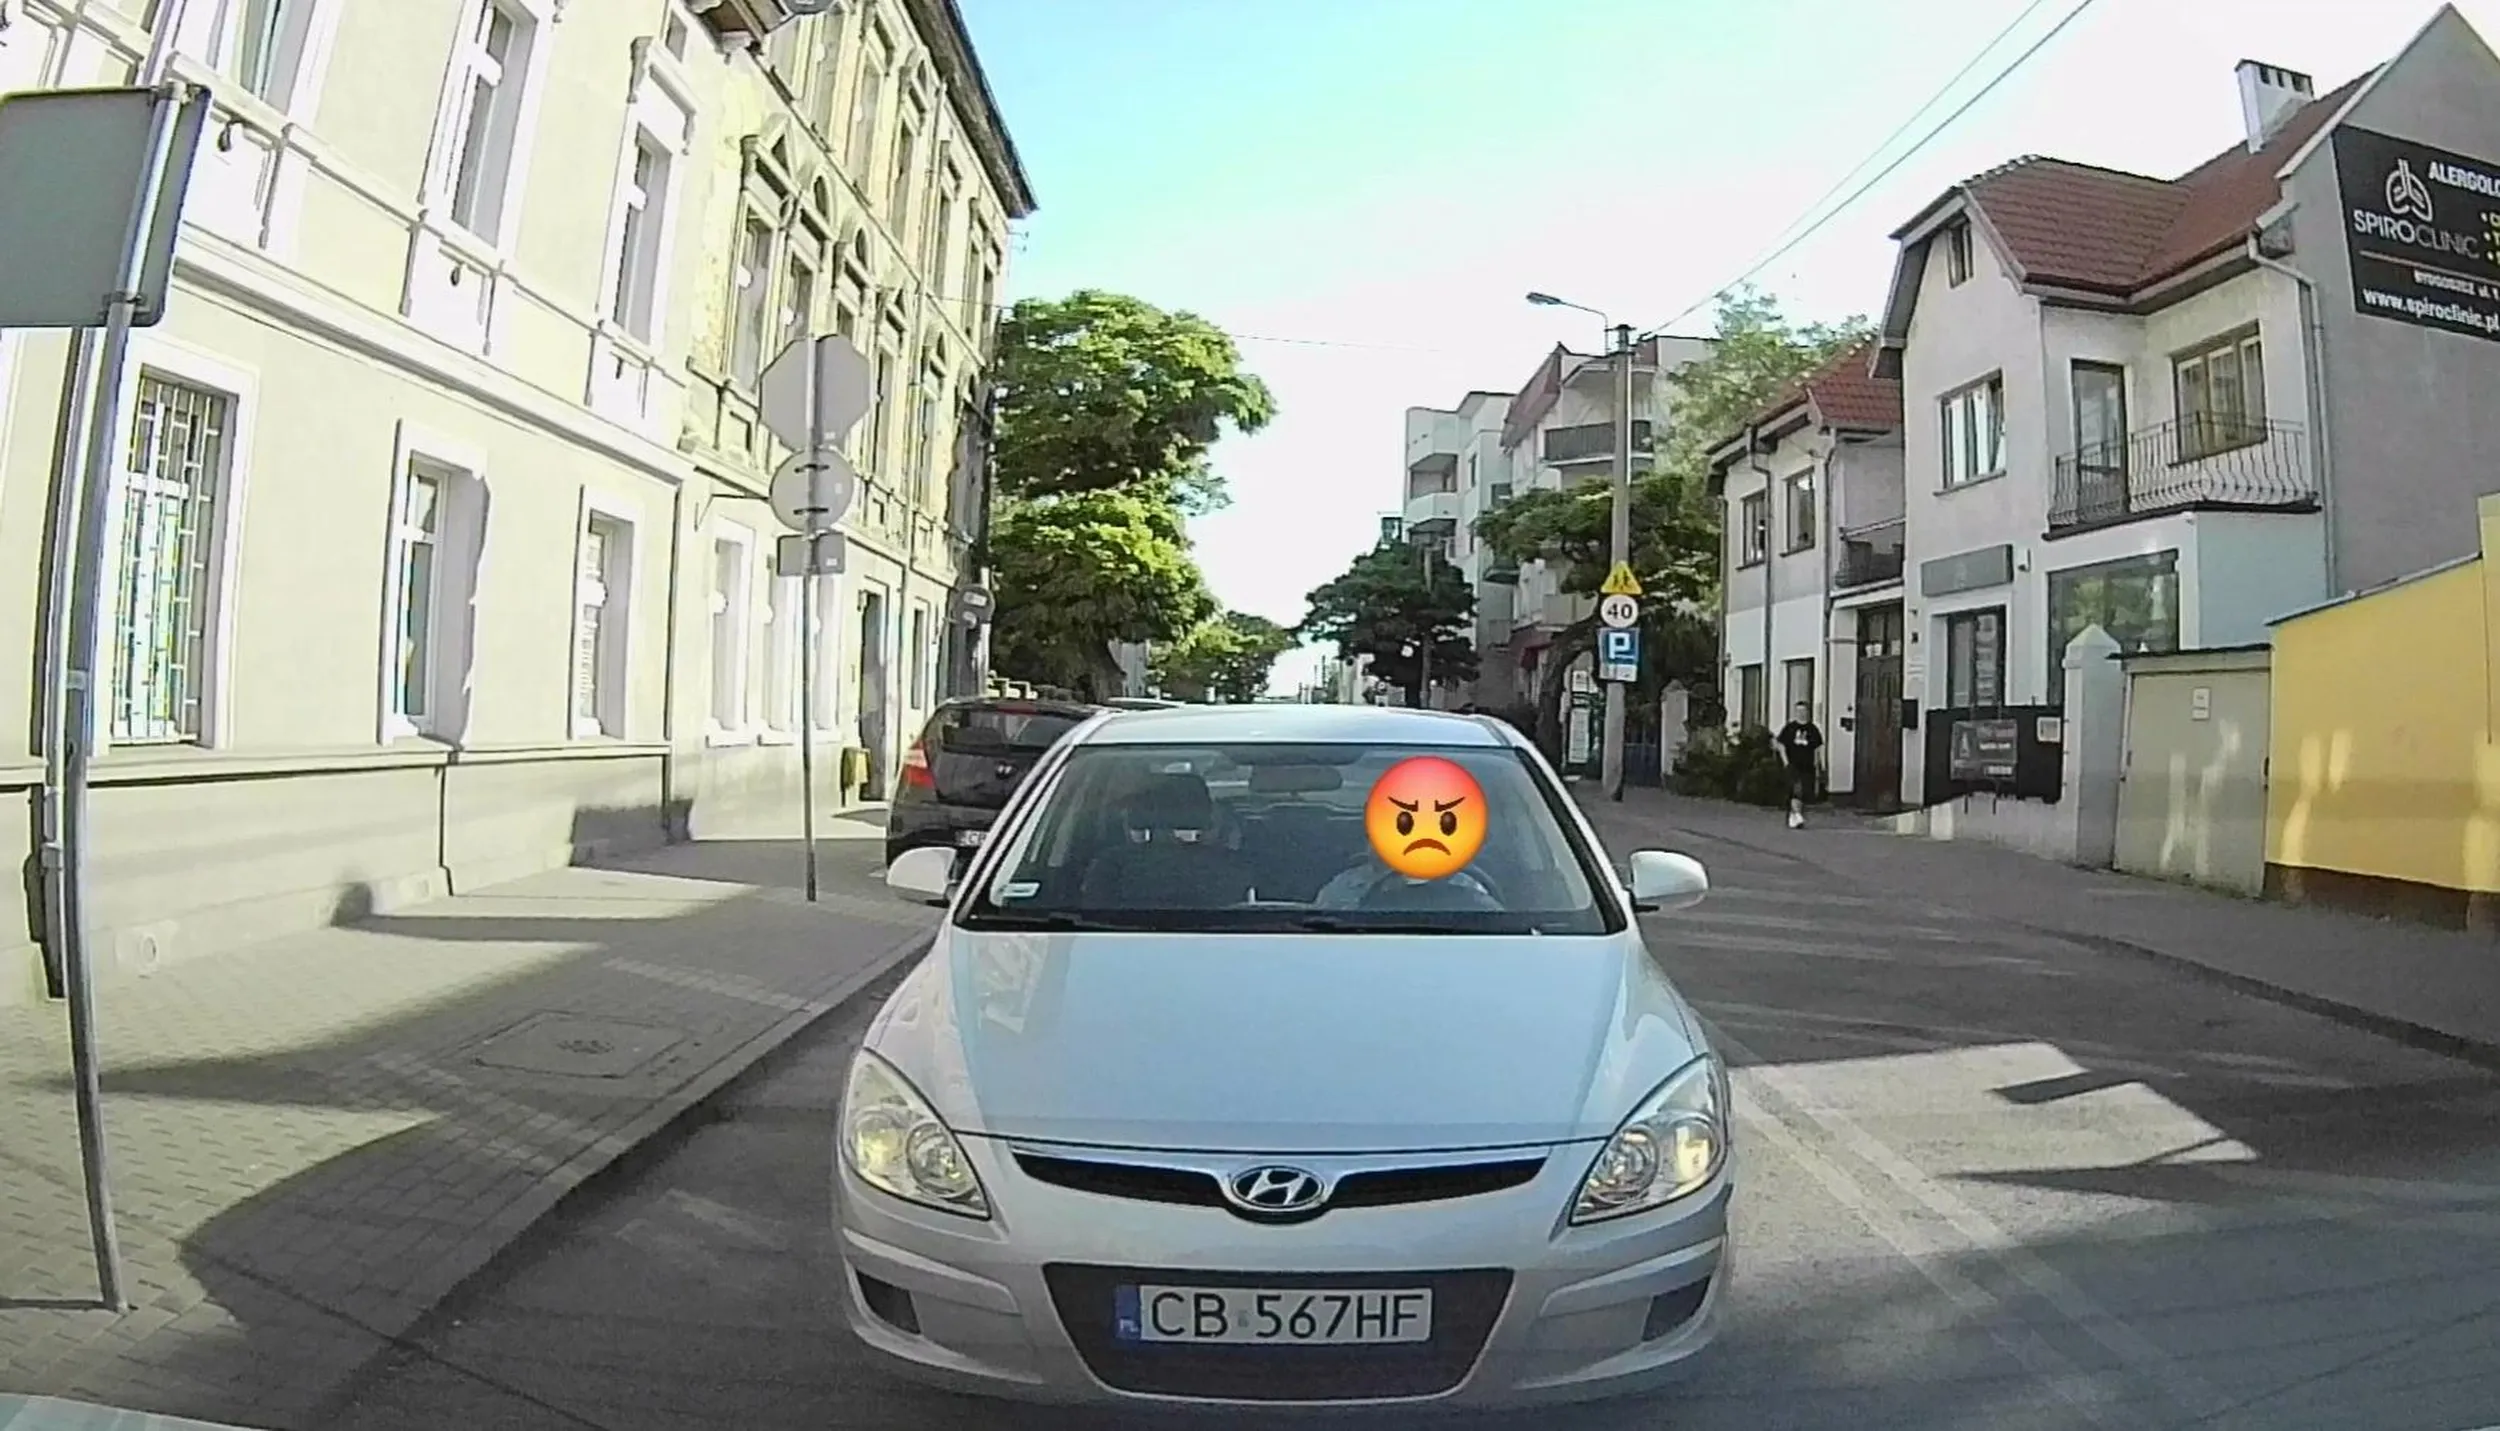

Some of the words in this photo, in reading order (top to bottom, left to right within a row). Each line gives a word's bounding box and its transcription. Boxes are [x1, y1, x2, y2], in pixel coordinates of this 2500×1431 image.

[2353, 209, 2480, 259] SPIROCLINIC
[2362, 288, 2500, 334] www.spiroclinic.pl
[1607, 603, 1633, 619] 40
[1609, 632, 1630, 659] P
[1152, 1291, 1228, 1337] CB
[1255, 1294, 1424, 1339] 567HF
